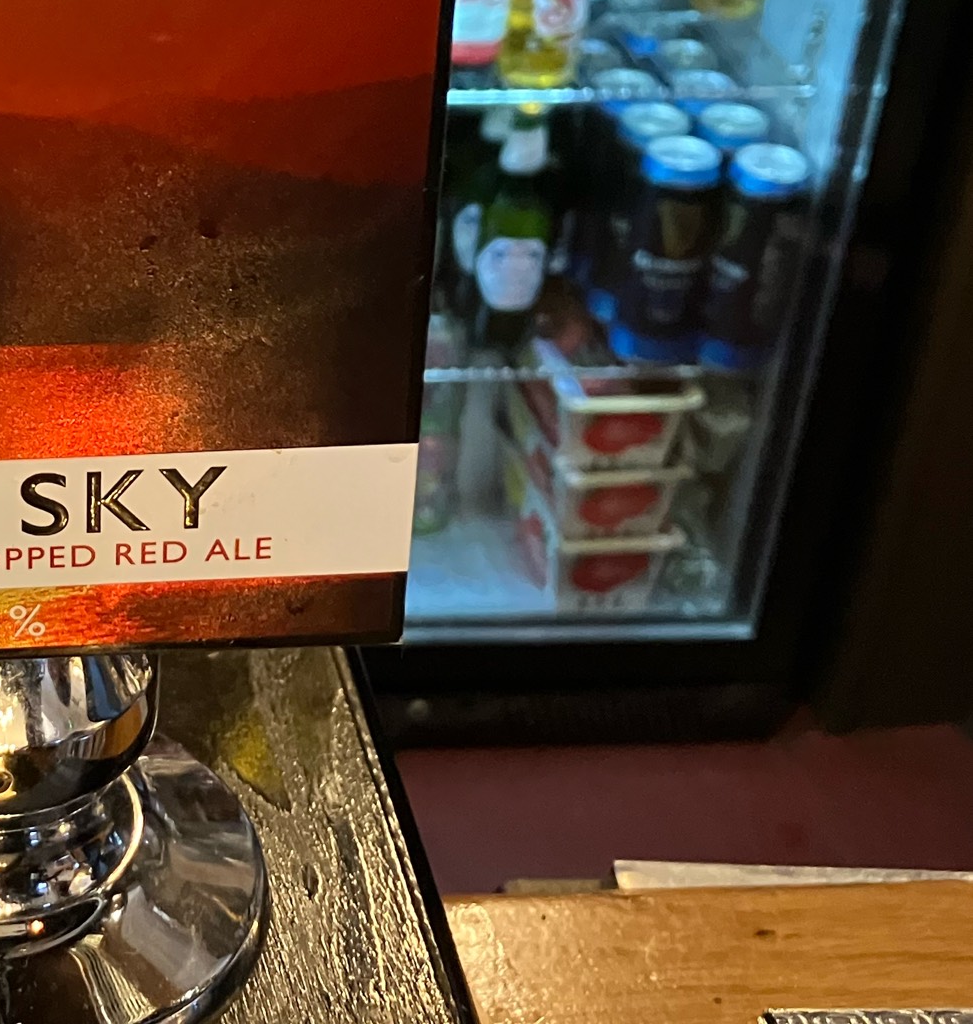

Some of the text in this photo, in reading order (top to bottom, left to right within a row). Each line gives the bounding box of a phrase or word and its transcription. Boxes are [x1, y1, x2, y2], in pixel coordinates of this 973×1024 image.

[19, 464, 229, 538] SKY
[114, 540, 189, 567] RED
[204, 536, 274, 563] ALE
